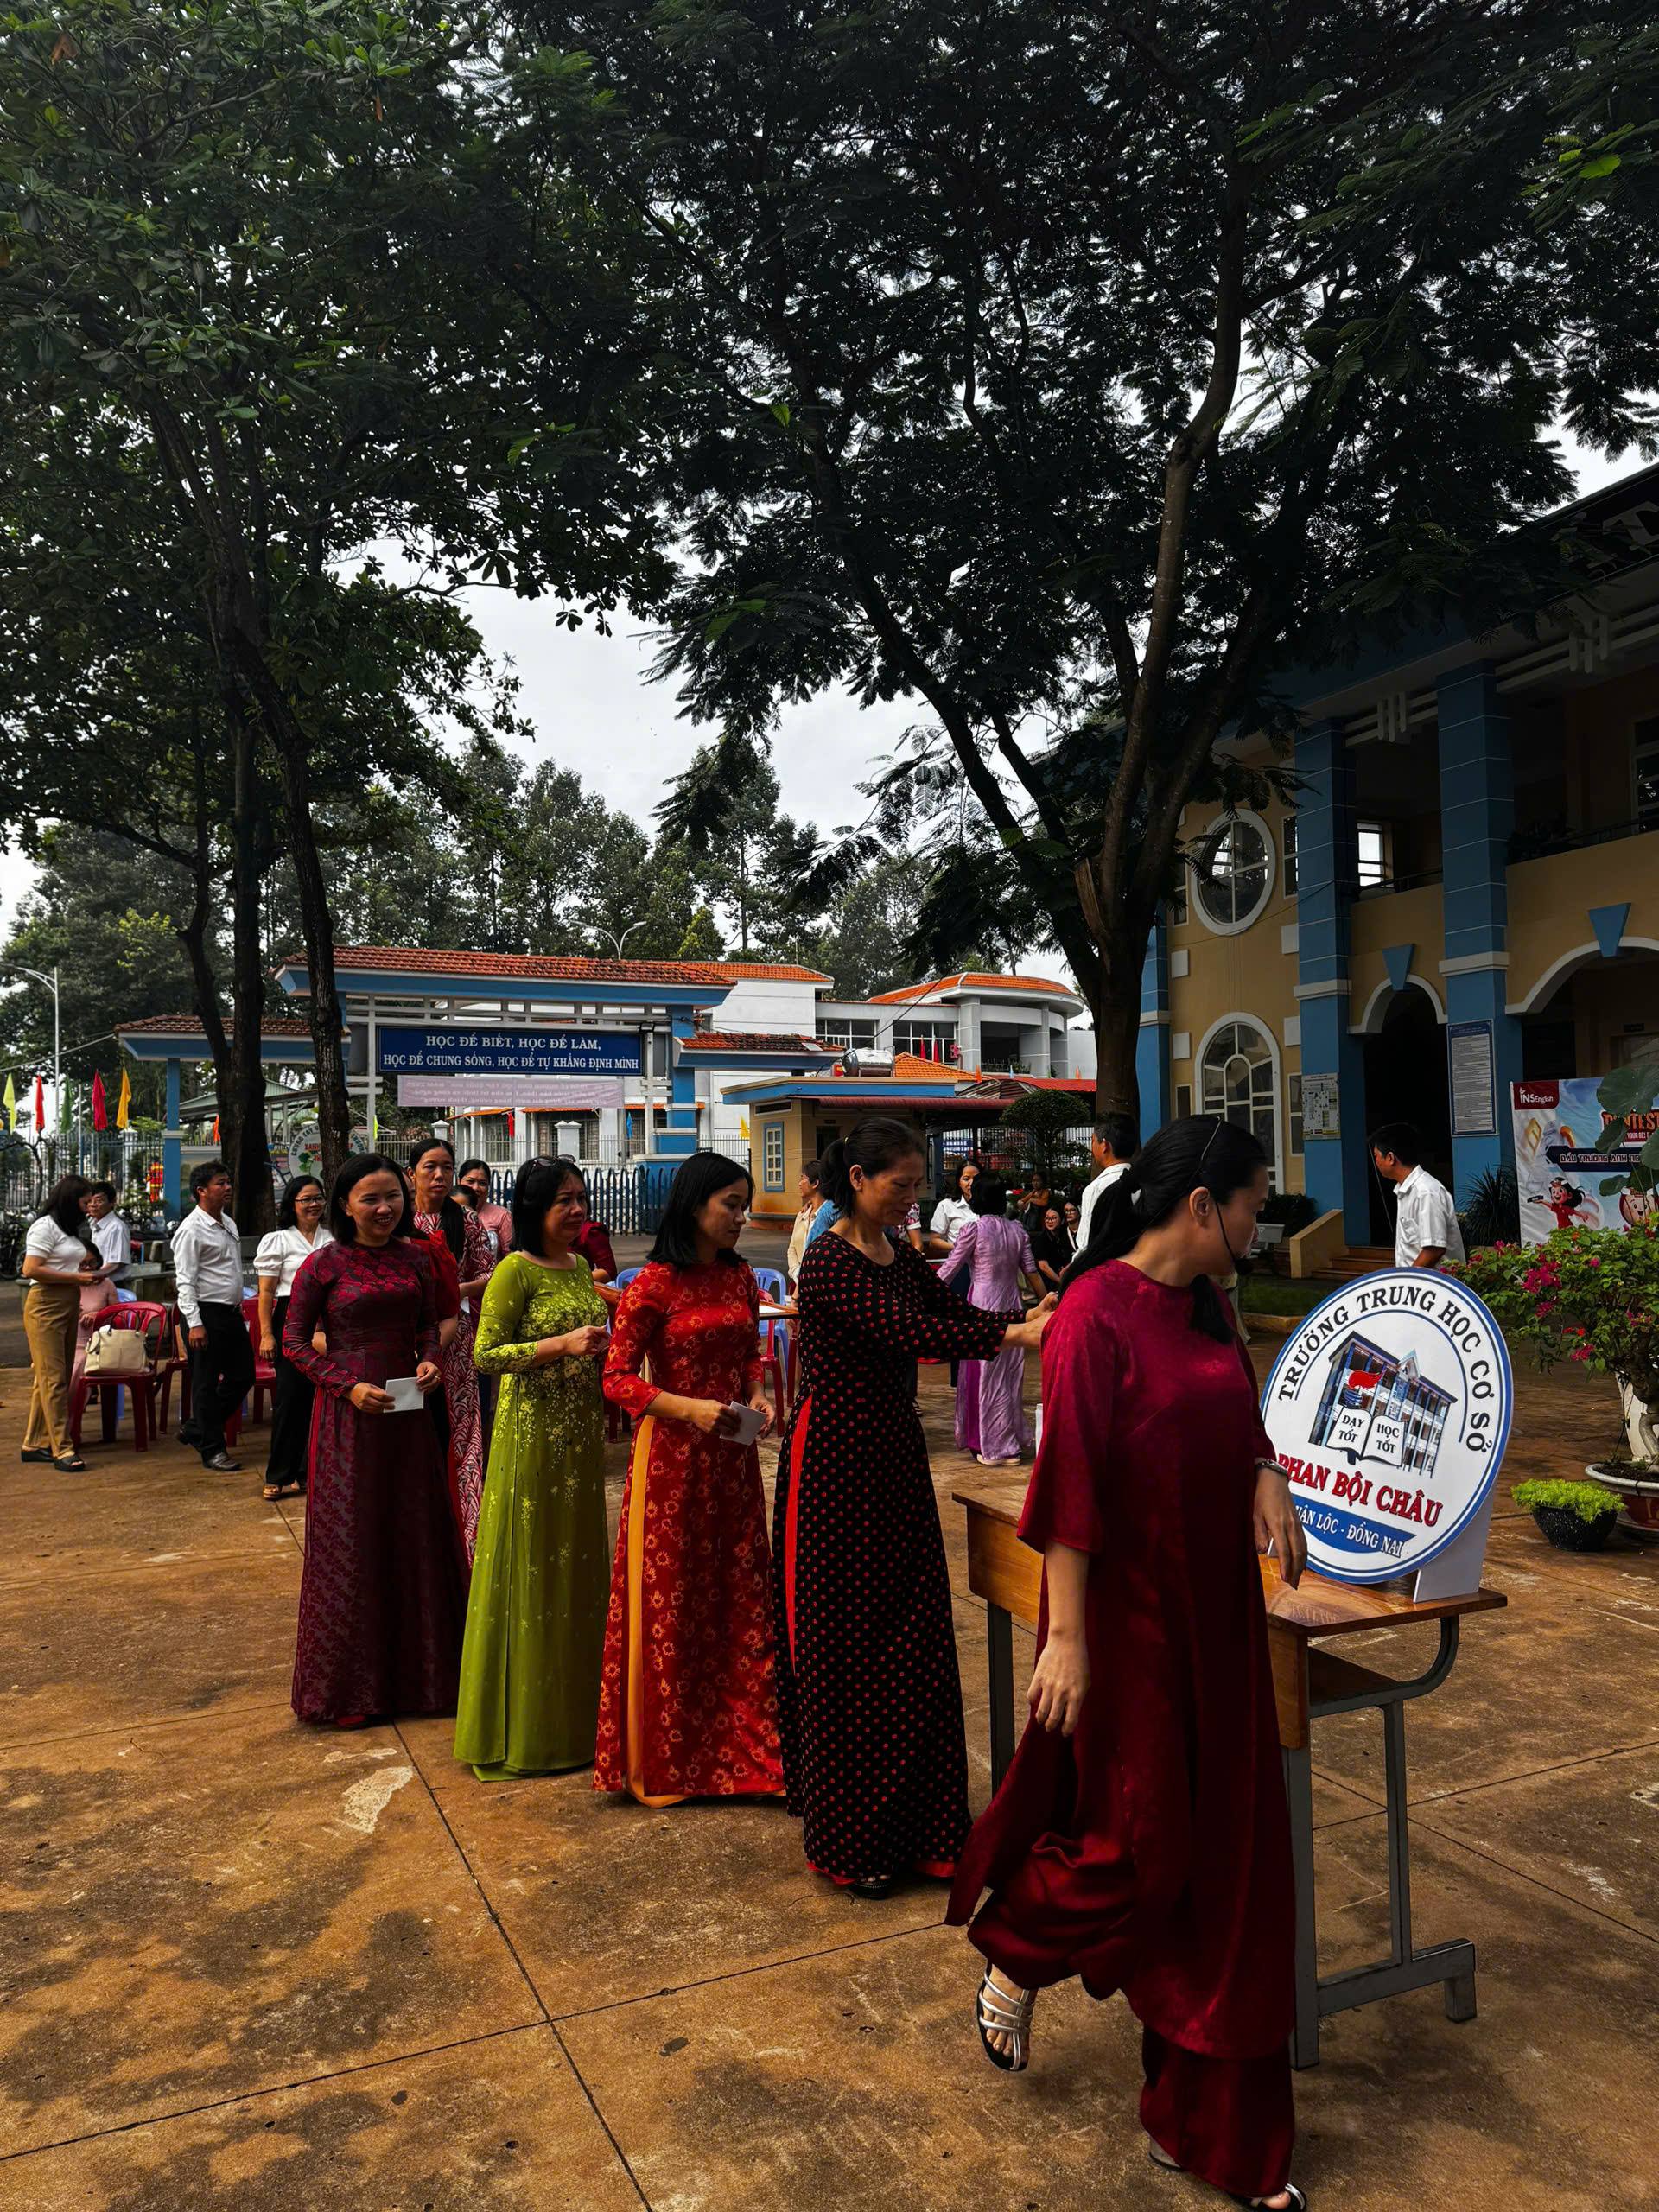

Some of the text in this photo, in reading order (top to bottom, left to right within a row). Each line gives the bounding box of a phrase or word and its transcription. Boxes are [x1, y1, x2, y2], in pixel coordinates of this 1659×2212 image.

[426, 1032, 601, 1051] HỌC ĐỂ BIẾT, HỌC ĐỂ LÀM,
[384, 1054, 406, 1067] HỌC
[409, 1050, 423, 1065] ĐỂ
[426, 1054, 461, 1066] CHUNG
[464, 1051, 495, 1068] SỐNG,
[497, 1056, 518, 1070] HỌC
[521, 1052, 535, 1067] ĐỂ
[537, 1056, 551, 1070] TỰ
[588, 1058, 612, 1071] ĐỊNH
[614, 1056, 639, 1069] MÌNH
[1278, 1285, 1495, 1454] TRƯỜNG TRUNG HỌC CƠ SỞ
[1338, 1414, 1365, 1443] DẠY TỐT
[1376, 1422, 1401, 1455] HỌC TỐT
[1332, 1471, 1373, 1507] BỘI
[1376, 1485, 1444, 1528] CHÂU
[1316, 1512, 1339, 1534] LỘC
[1346, 1520, 1380, 1548] ĐỒNG
[1380, 1535, 1405, 1559] NAI
